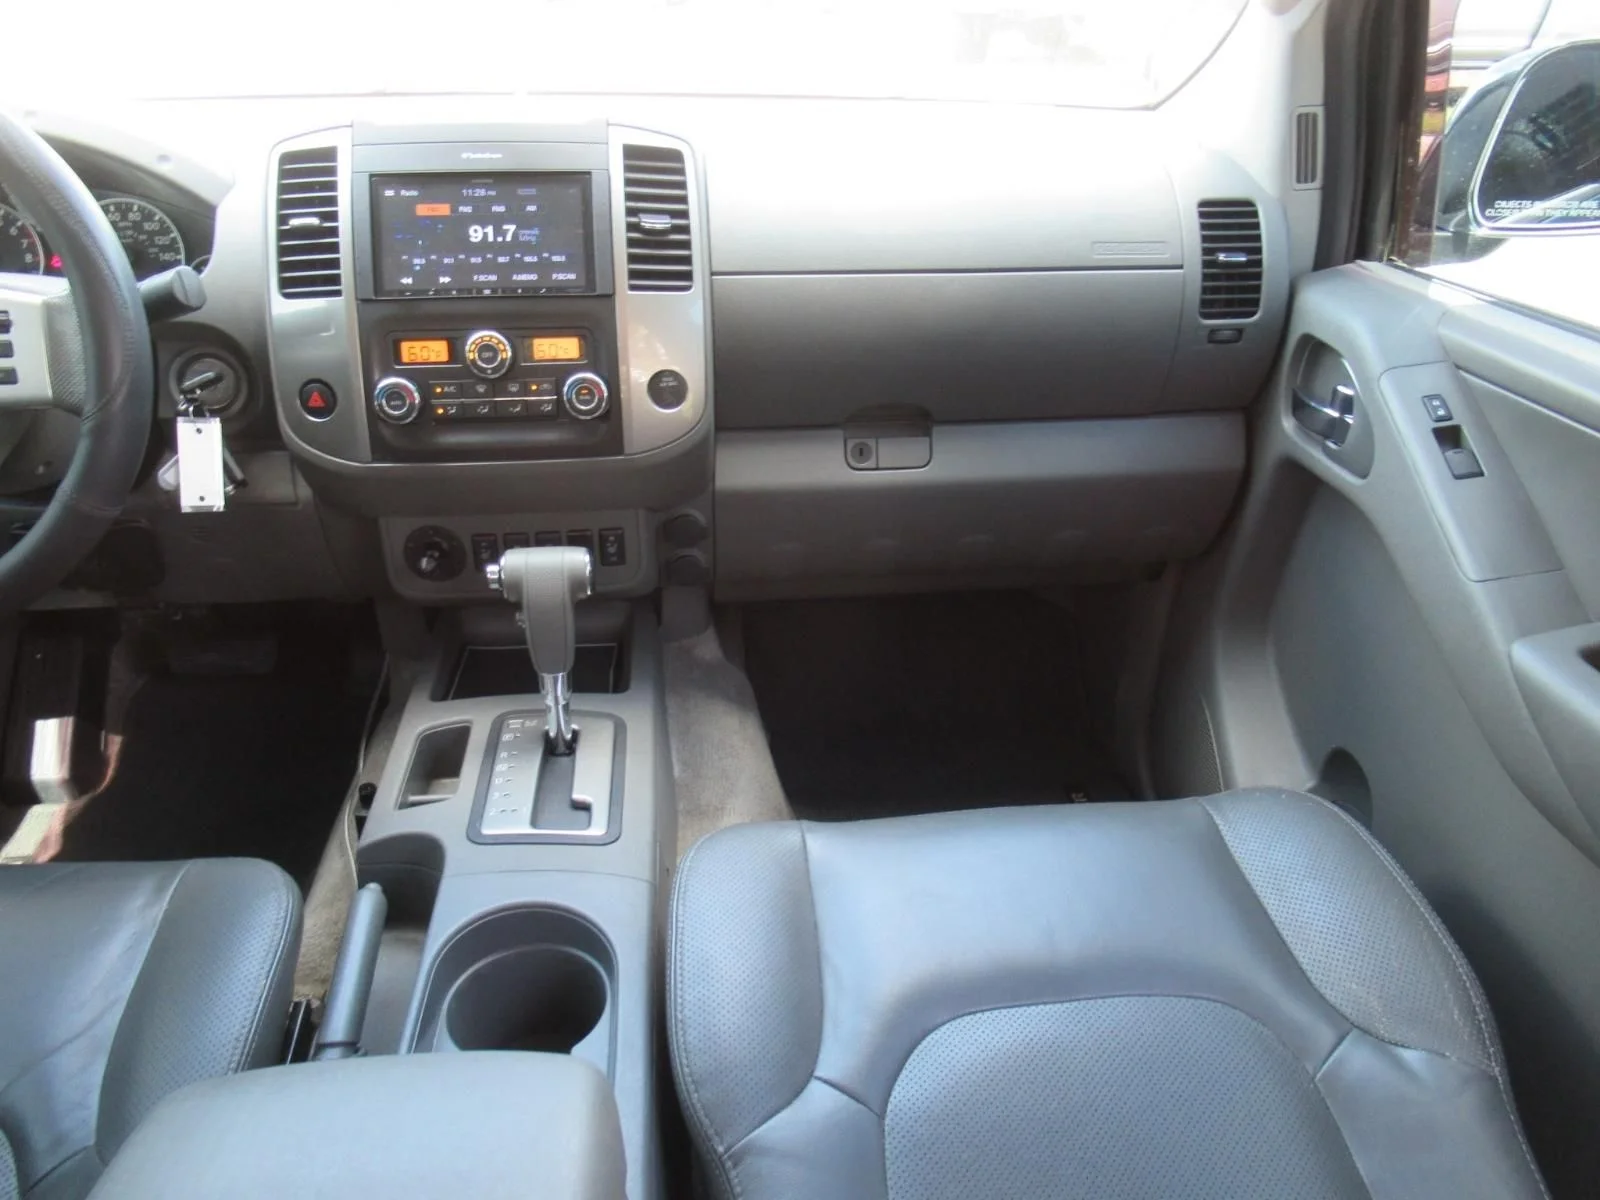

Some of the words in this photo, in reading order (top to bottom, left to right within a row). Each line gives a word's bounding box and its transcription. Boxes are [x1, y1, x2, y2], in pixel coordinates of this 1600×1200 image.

[143, 222, 160, 231] 100
[468, 224, 517, 243] 91.7
[159, 251, 176, 261] 140
